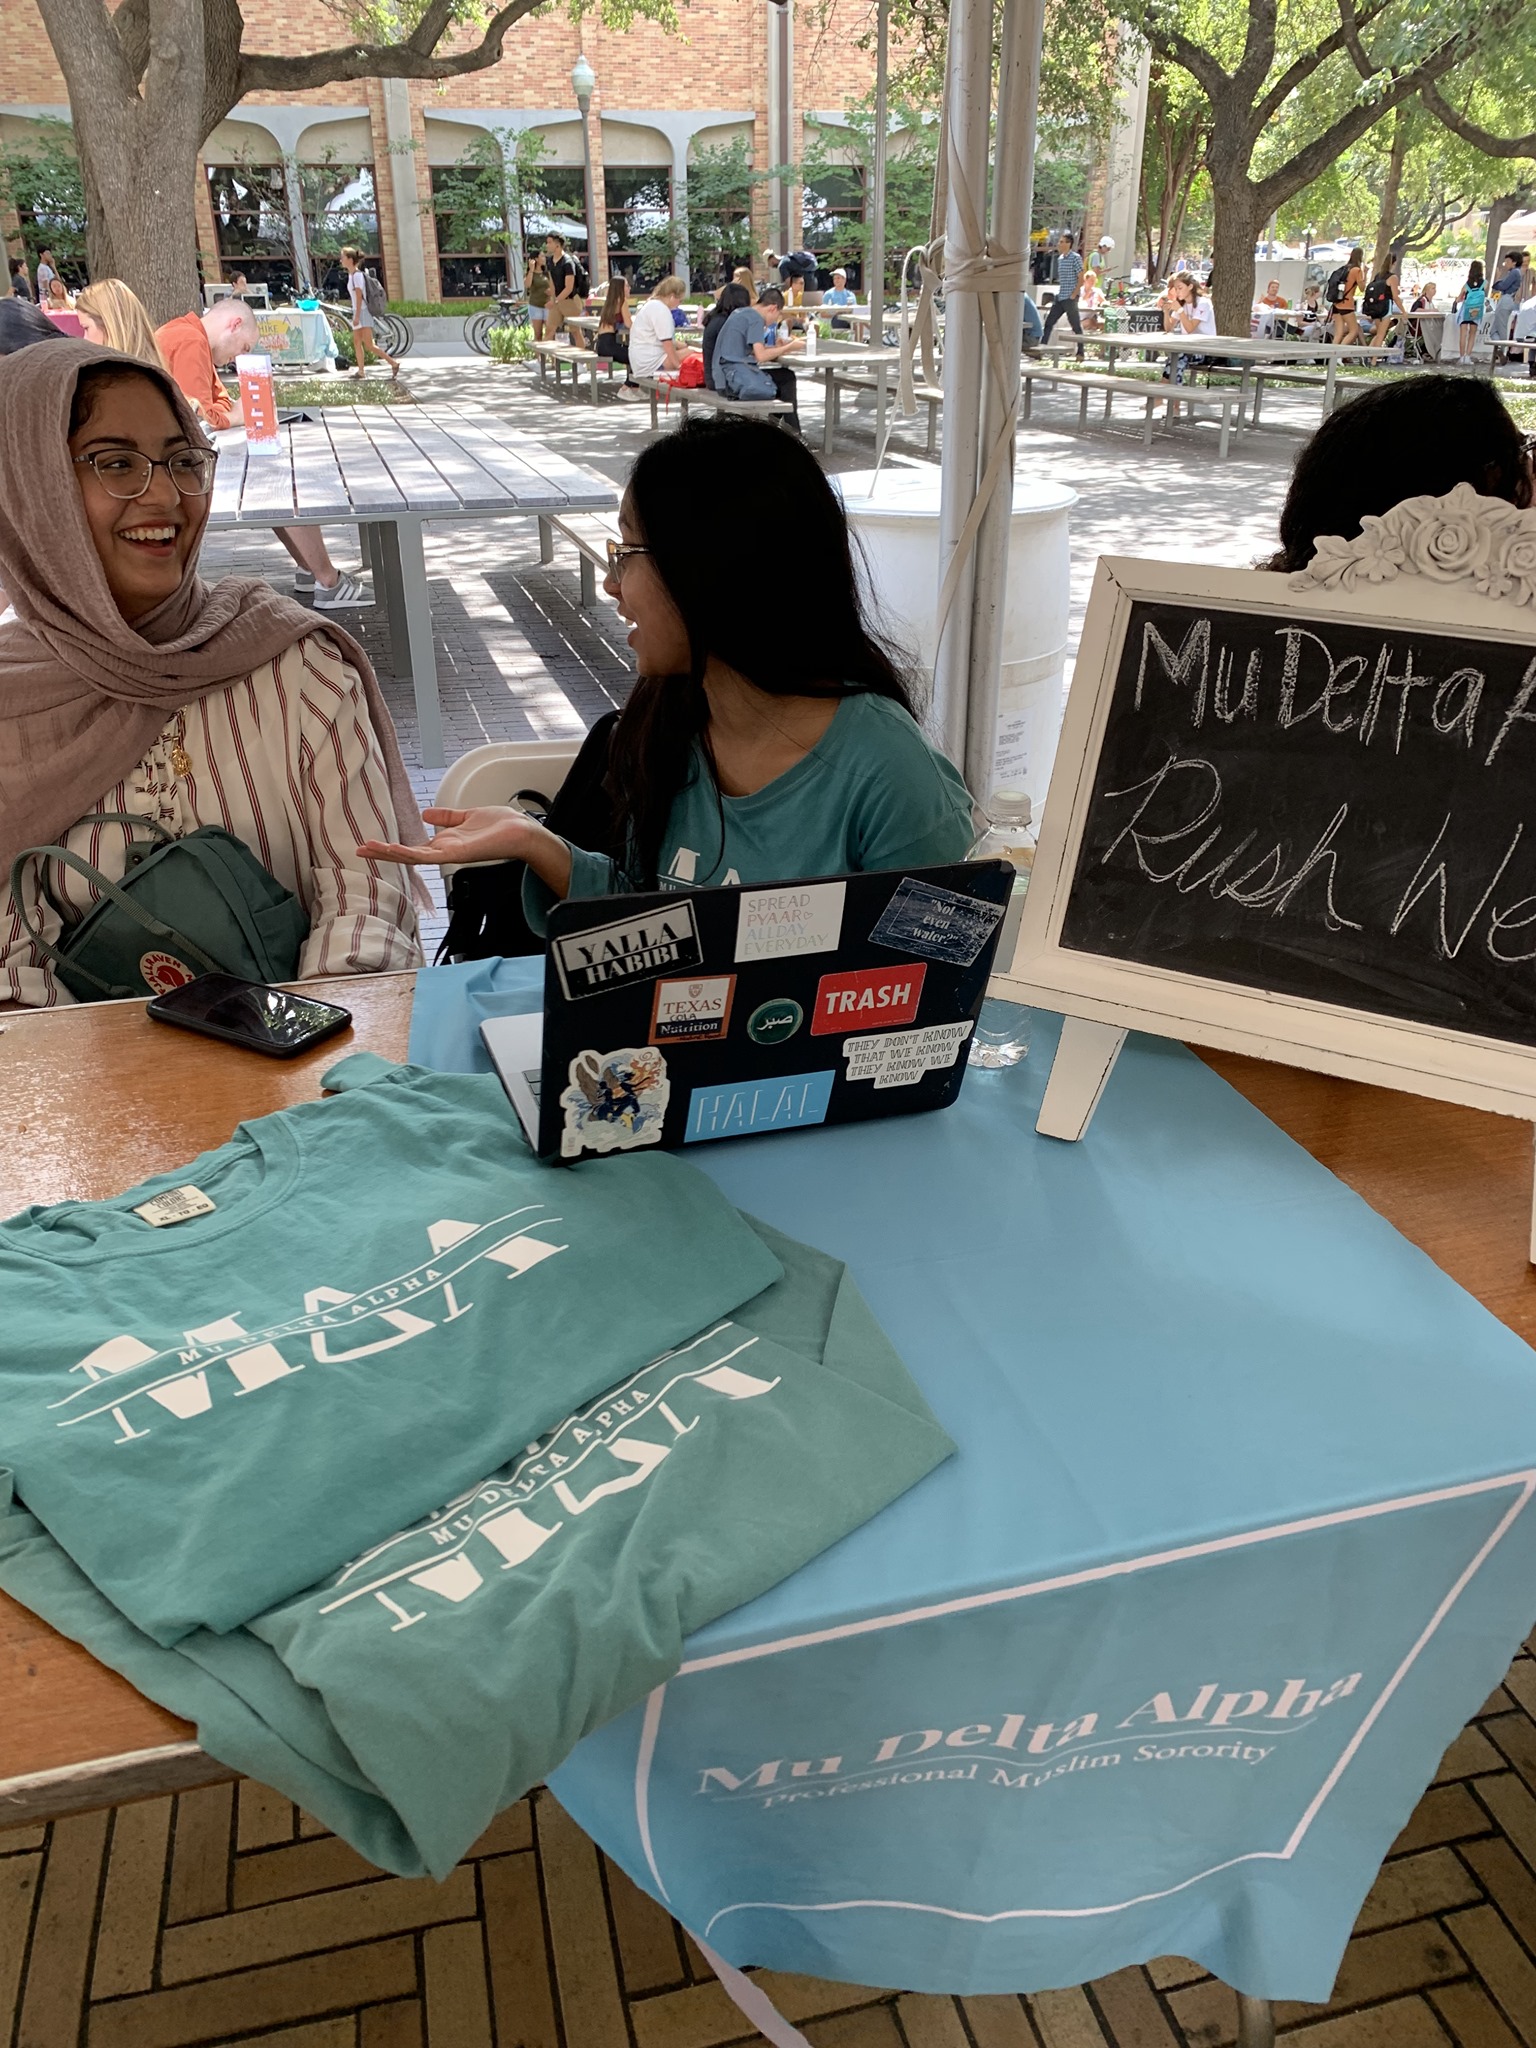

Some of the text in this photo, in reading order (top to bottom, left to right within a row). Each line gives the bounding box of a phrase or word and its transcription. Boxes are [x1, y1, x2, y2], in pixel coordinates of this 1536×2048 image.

[259, 324, 279, 333] HIKE
[1129, 323, 1162, 333] SKATE
[1135, 315, 1160, 323] TEXAS
[1133, 618, 1263, 728] Mu
[1275, 624, 1485, 755] Delta
[1101, 754, 1364, 932] Rush
[748, 893, 811, 913] SPREAD
[747, 909, 802, 927] PYAAR
[922, 915, 951, 930] even
[577, 922, 679, 964] YALLA
[744, 933, 829, 956] EVERYDAY
[585, 943, 680, 985] HABIBI
[664, 998, 722, 1015] TEXAS
[826, 982, 912, 1015] TRASH
[661, 1022, 718, 1035] Nutrition
[756, 1014, 794, 1031] صبر
[848, 1025, 967, 1053] THEY DON'T KNOW
[854, 1041, 955, 1064] THAT WE KNOW
[851, 1053, 953, 1077] THEY KNOW WE
[879, 1070, 919, 1085] KNOW
[696, 1082, 819, 1134] HALAL
[177, 1268, 443, 1365] MU DELTA ALPHA
[429, 1514, 474, 1546] MU
[571, 1389, 651, 1445] APHA
[692, 1672, 1363, 1796] Mu Delta Alpha
[764, 1741, 1276, 1809] Professional Muslim Sorority
